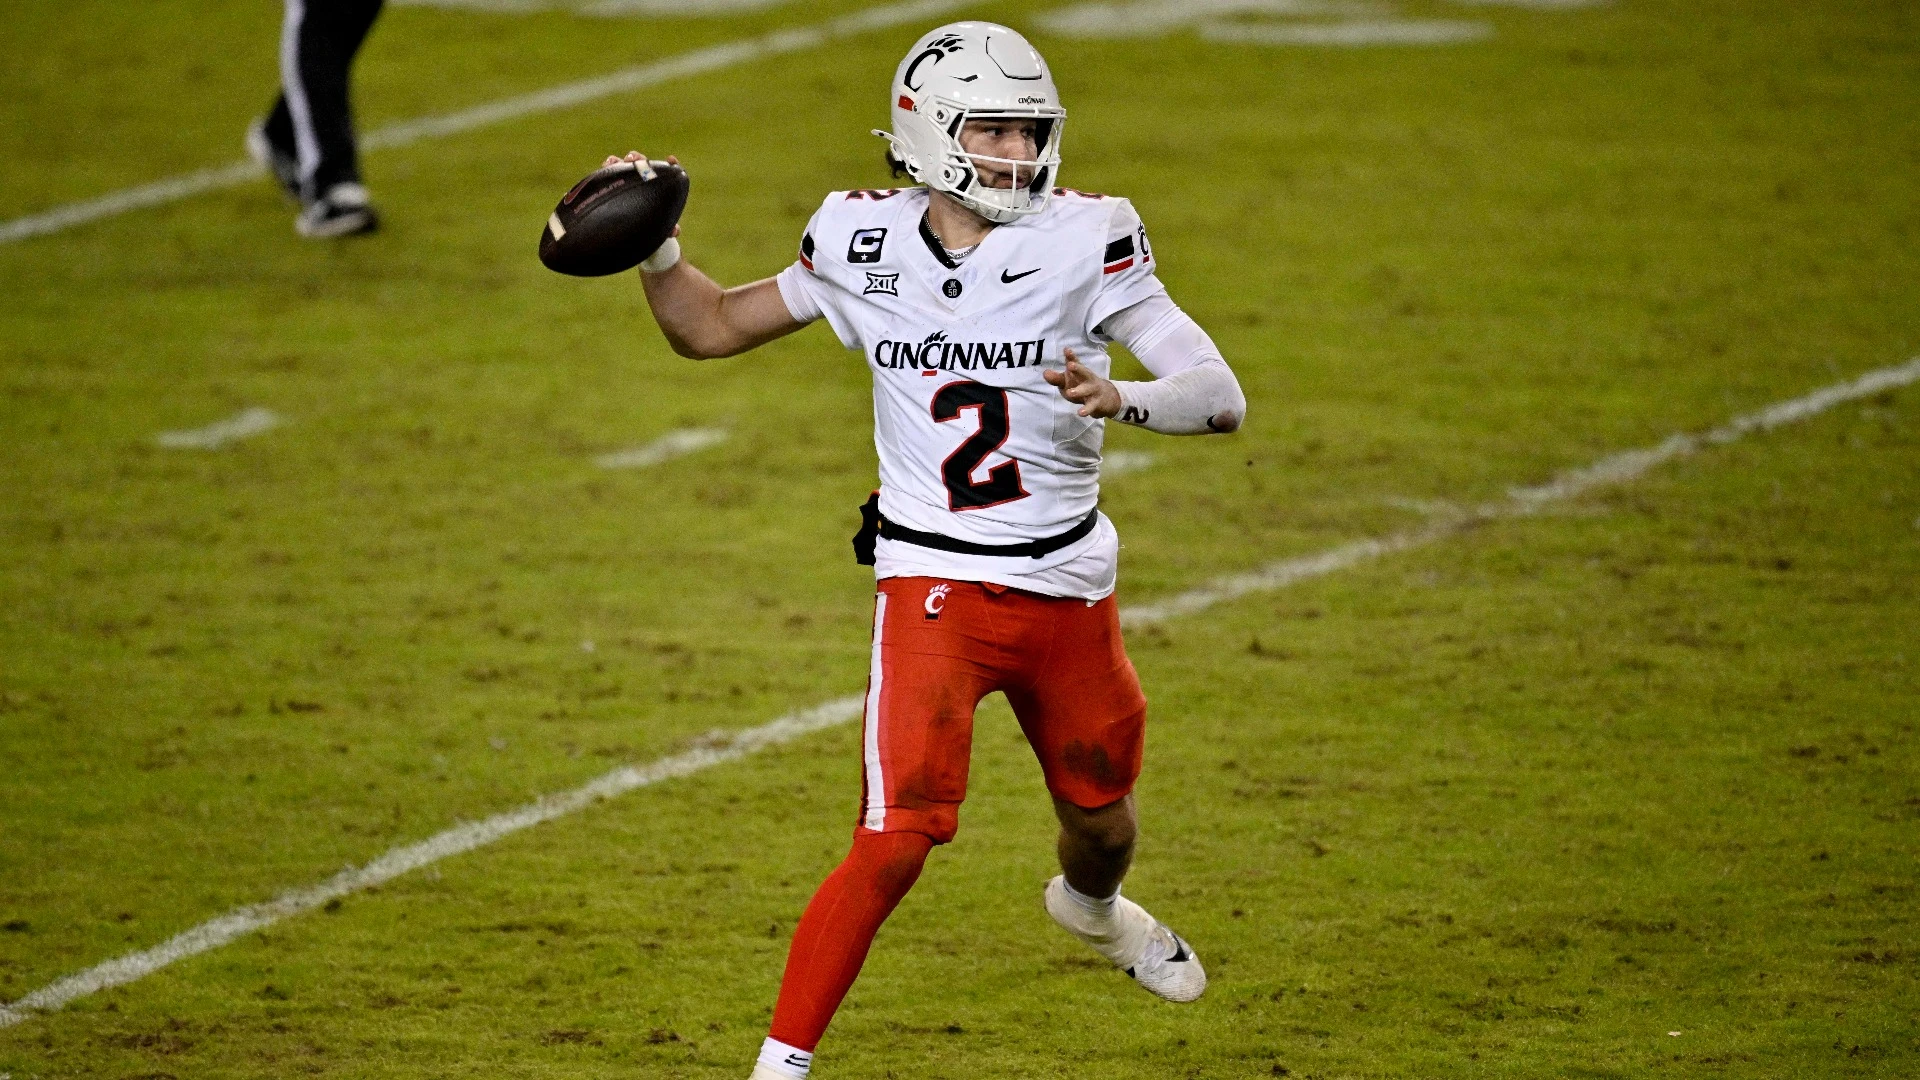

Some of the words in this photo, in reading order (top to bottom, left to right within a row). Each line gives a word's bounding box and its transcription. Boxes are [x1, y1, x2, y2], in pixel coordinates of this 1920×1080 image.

[853, 229, 883, 253] C
[868, 276, 896, 292] XII
[875, 333, 1046, 371] CINCINNATI
[1121, 405, 1149, 424] 2
[930, 380, 1032, 511] 2
